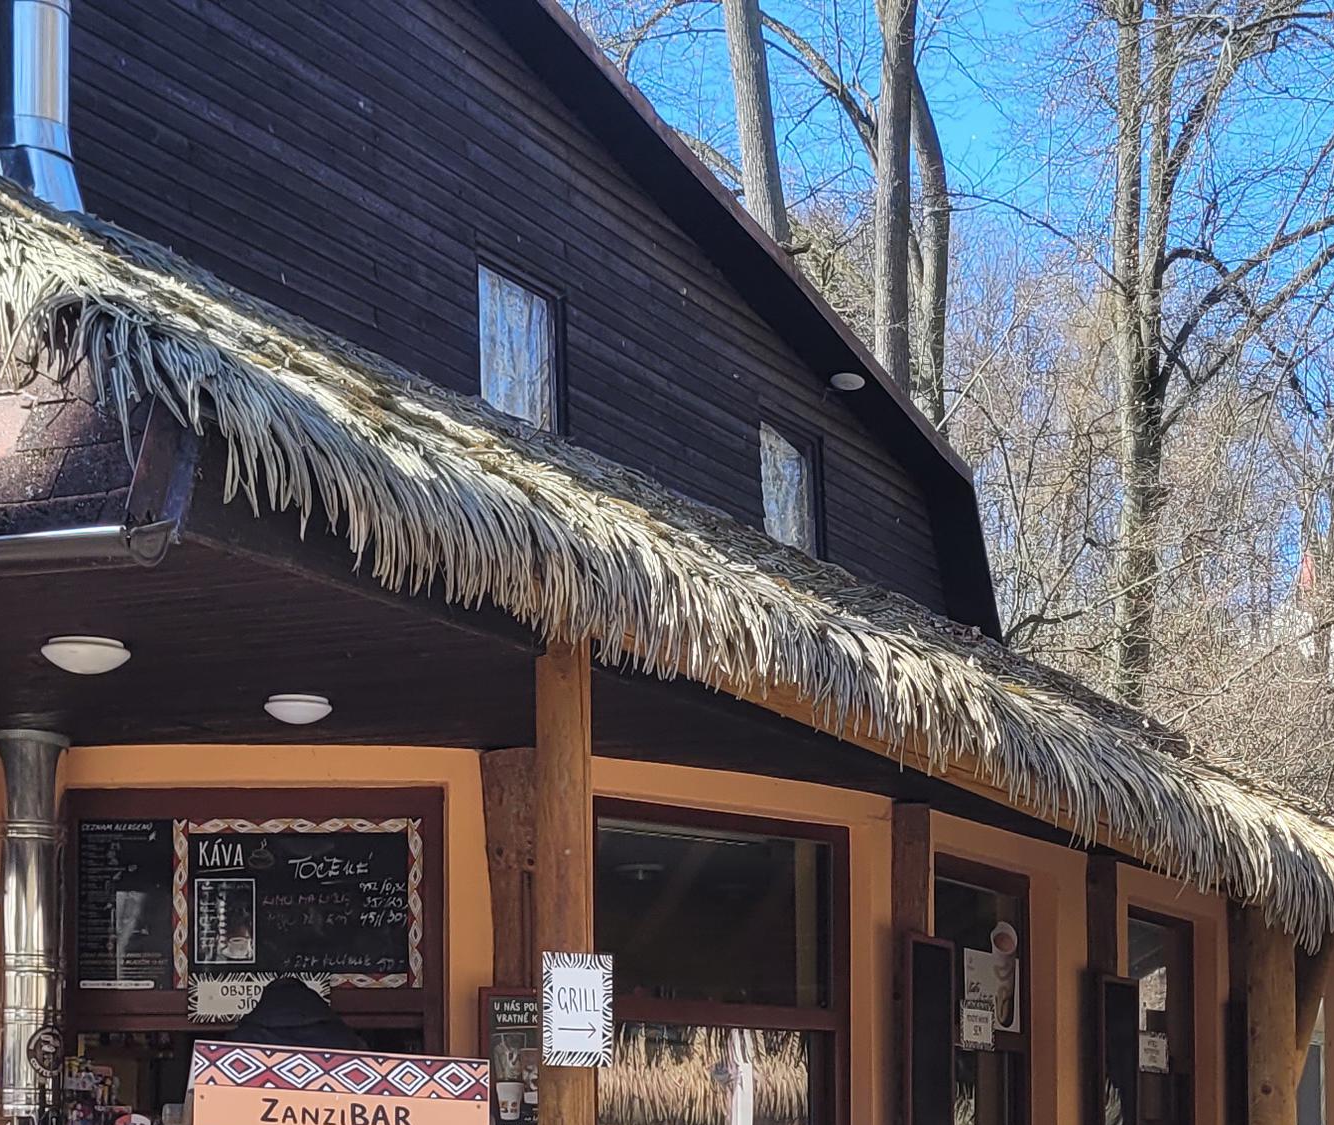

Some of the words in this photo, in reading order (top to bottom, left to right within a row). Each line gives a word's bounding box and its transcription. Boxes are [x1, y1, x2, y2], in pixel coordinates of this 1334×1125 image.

[198, 838, 244, 867] KÁVA
[494, 1001, 500, 1011] U
[503, 999, 521, 1011] NÁS
[557, 986, 601, 1013] GRILL
[496, 1012, 529, 1024] VRATNÉ
